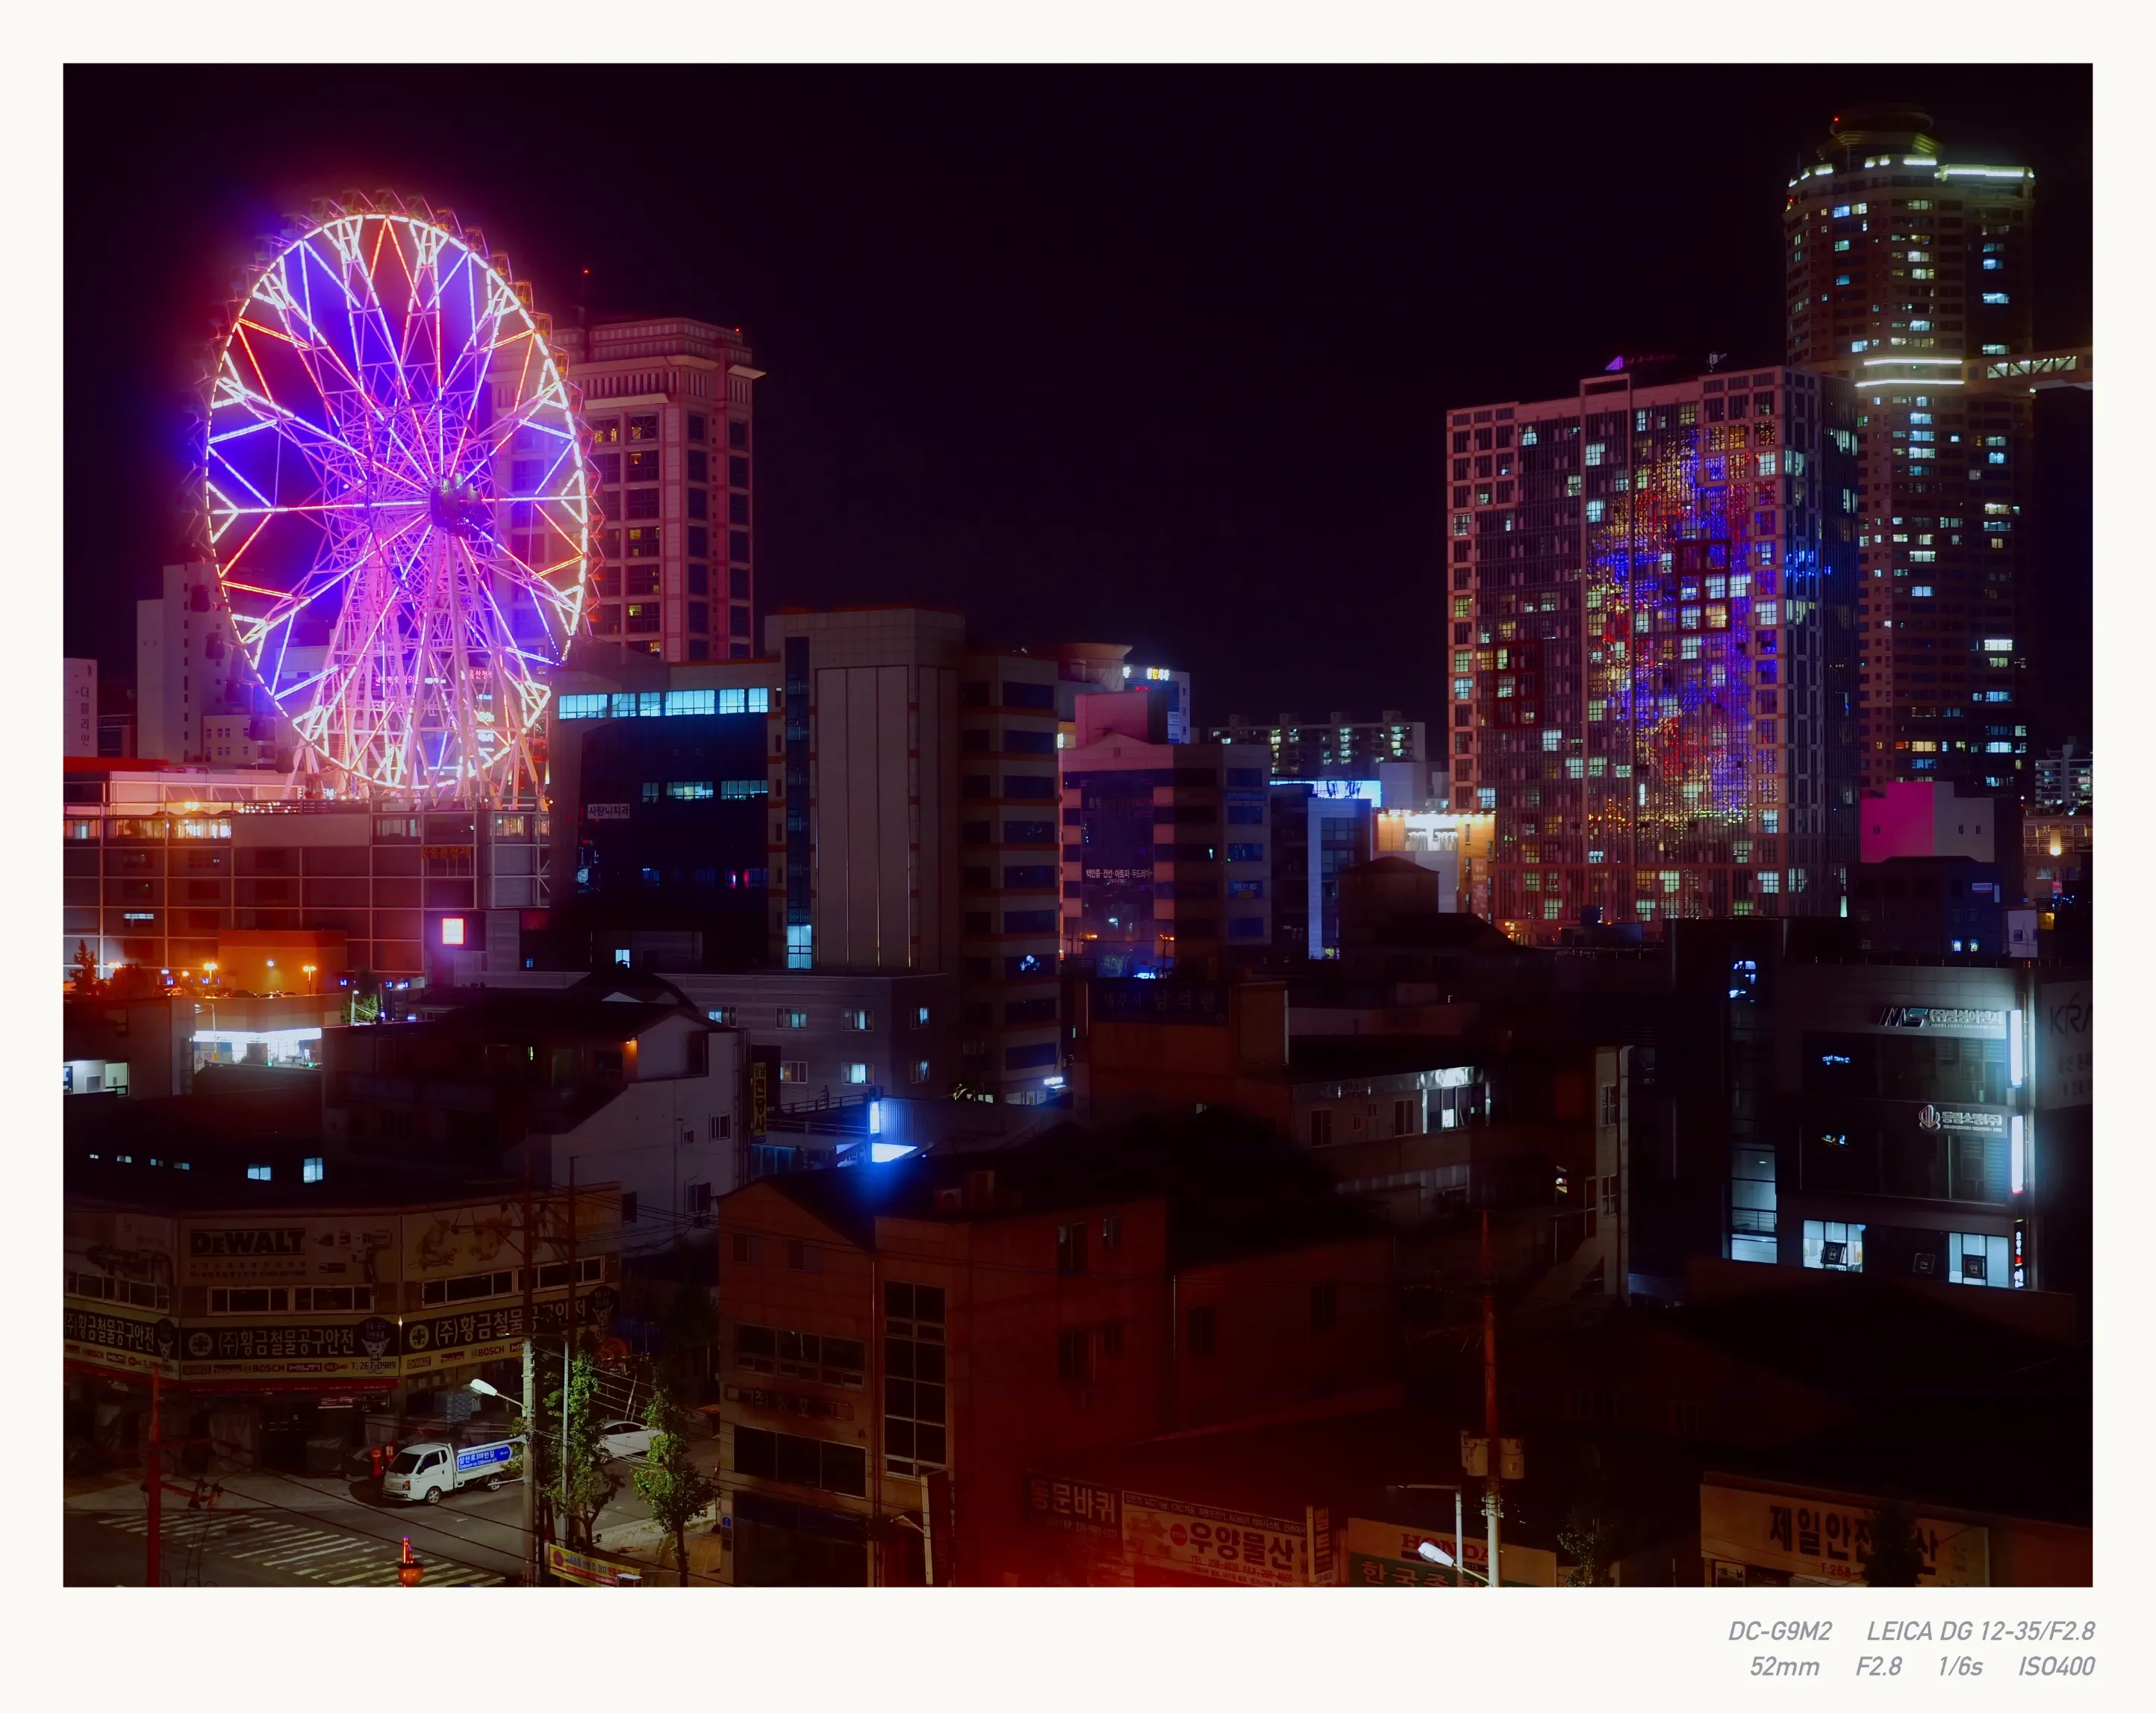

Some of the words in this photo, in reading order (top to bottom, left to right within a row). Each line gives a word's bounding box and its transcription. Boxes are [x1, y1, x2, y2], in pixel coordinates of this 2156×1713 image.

[219, 1328, 355, 1357] (주)황금철물공구안전
[478, 1346, 505, 1357] BOSCH
[252, 1363, 284, 1373] BOSCH
[288, 1364, 322, 1372] HILTI
[359, 1361, 396, 1371] 267-0989
[1189, 1521, 1294, 1572] 우양물산
